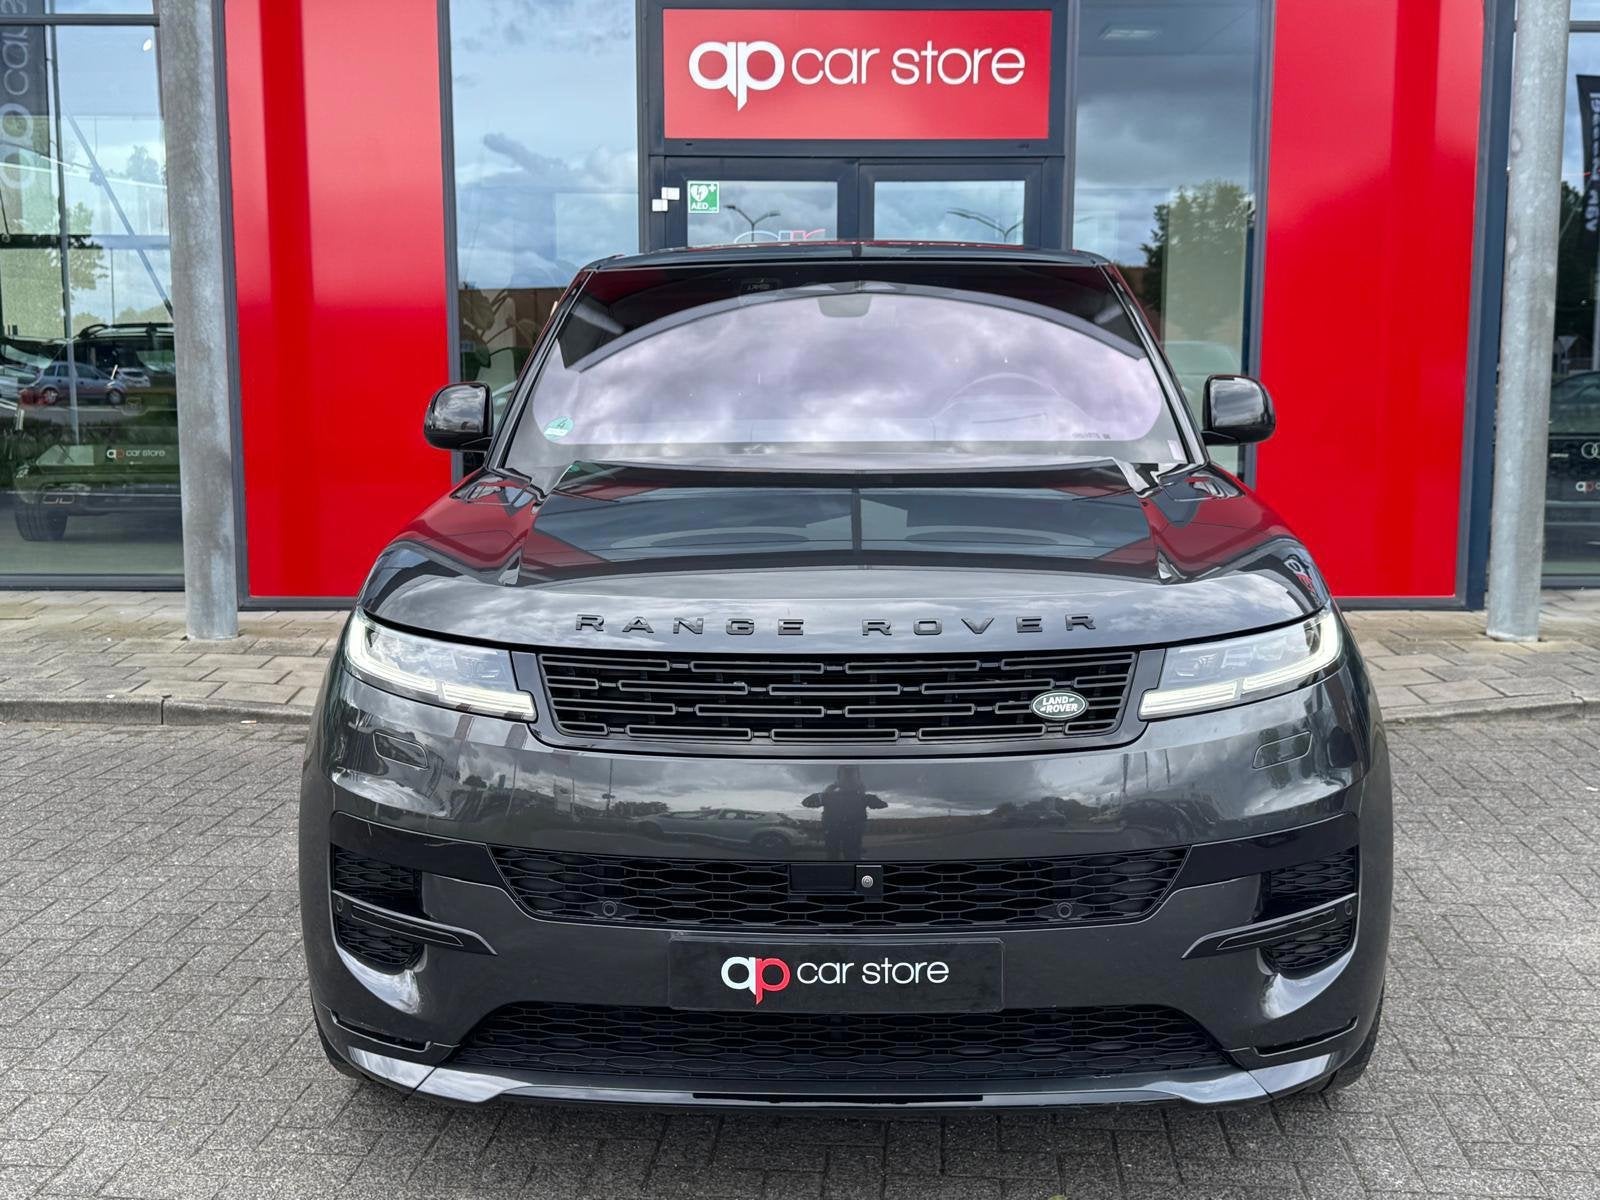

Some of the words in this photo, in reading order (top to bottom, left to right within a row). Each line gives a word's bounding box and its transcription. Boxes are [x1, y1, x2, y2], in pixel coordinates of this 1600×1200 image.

[689, 40, 785, 112] ap
[791, 48, 880, 85] car
[891, 40, 1026, 85] store
[691, 202, 709, 210] AED
[575, 614, 805, 636] RANGE
[861, 612, 1097, 636] ROVER
[1042, 696, 1068, 705] LAND
[1046, 703, 1078, 713] ROVER
[721, 956, 791, 1005] ap
[797, 961, 854, 985] car
[861, 957, 950, 985] store
